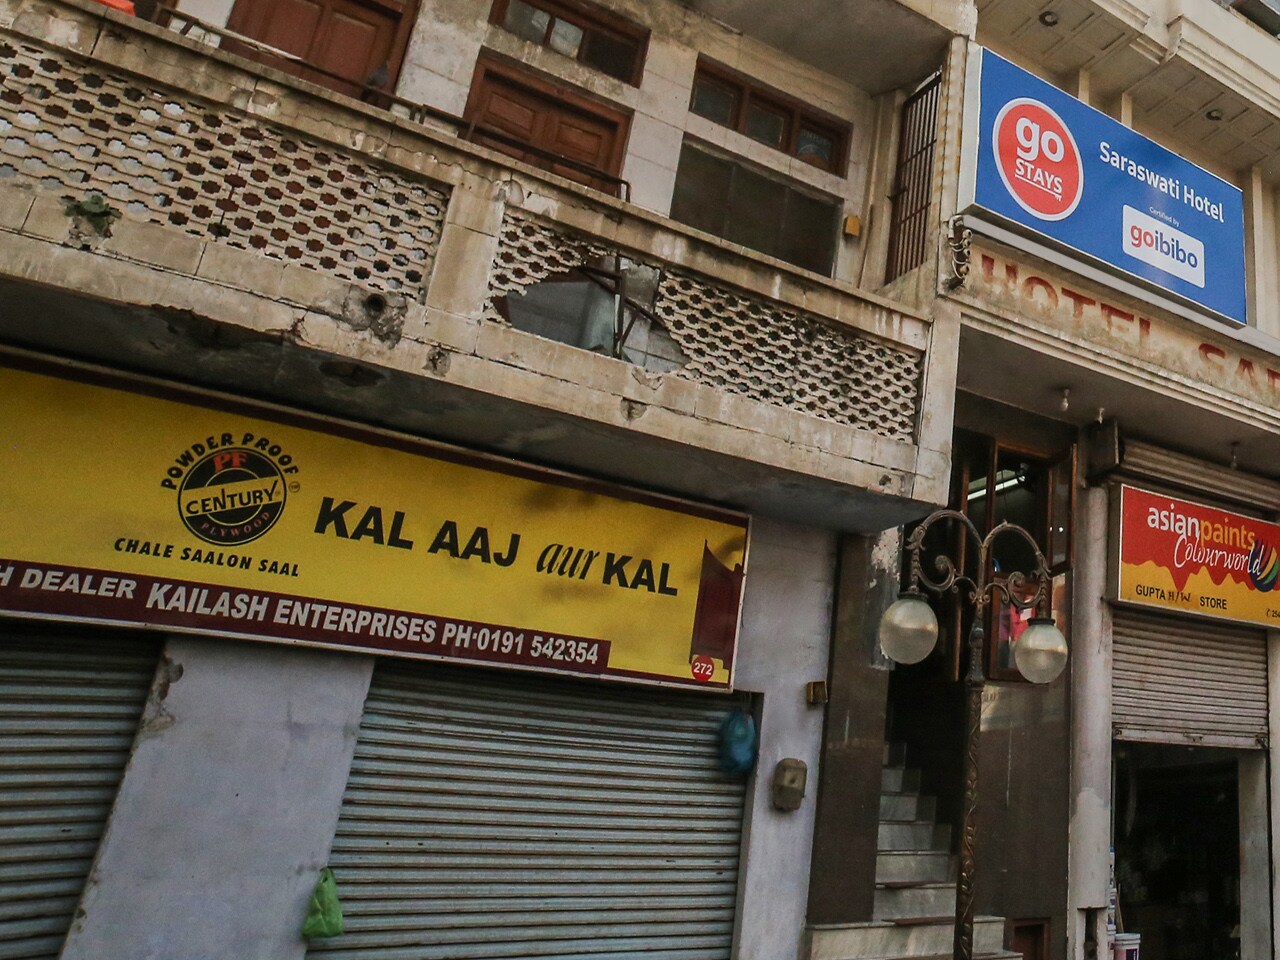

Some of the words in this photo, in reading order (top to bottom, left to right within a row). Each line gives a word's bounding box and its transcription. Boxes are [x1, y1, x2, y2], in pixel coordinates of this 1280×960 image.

[1016, 117, 1065, 162] go
[1015, 158, 1063, 194] STAYS
[1099, 141, 1180, 200] Saraswati
[1183, 185, 1225, 223] Hotel
[1130, 225, 1198, 269] goibibo
[161, 432, 235, 490] POWDER
[241, 433, 299, 475] PROOF
[212, 451, 248, 473] PF
[186, 479, 278, 515] CENTURY
[201, 512, 270, 537] PLYWOOD
[114, 537, 174, 559] CHALE
[180, 547, 252, 570] SAALON
[258, 559, 299, 577] SAAL
[314, 496, 414, 550] KAL
[428, 520, 521, 567] AAJ
[536, 543, 600, 581] aur
[602, 552, 678, 596] KAL
[1173, 534, 1265, 576] Colourworld
[20, 568, 138, 600] DEALER
[146, 582, 270, 622] KAILASH
[273, 599, 438, 643] ENTERPRISES
[530, 635, 599, 665] 542354
[1135, 584, 1166, 601] GUPTA
[1199, 596, 1228, 610] STORE
[693, 661, 713, 676] 272
